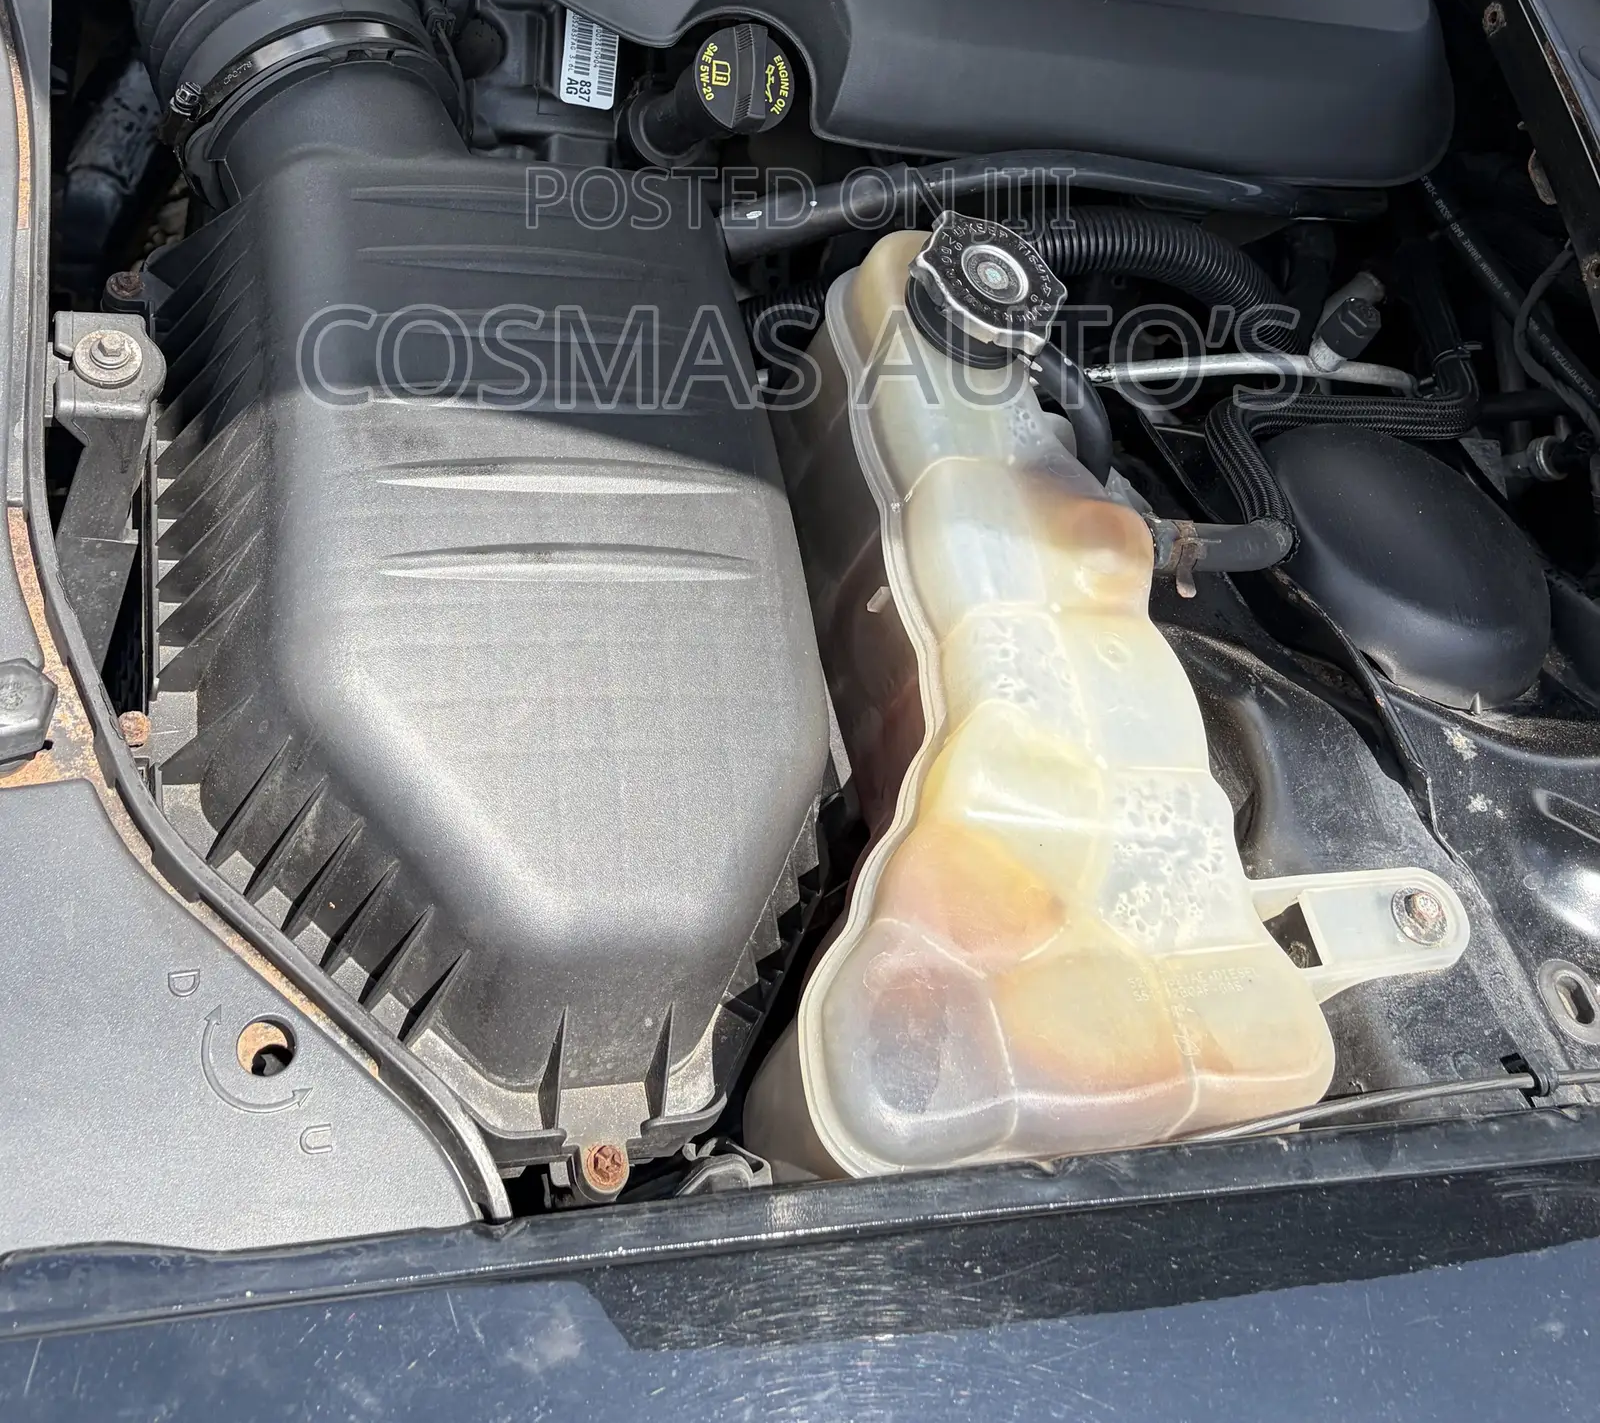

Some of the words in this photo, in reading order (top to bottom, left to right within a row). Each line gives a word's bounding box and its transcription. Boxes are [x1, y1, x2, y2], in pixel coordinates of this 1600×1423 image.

[701, 42, 718, 64] SAE
[565, 77, 579, 95] AG
[699, 64, 715, 101] 5W-20
[773, 54, 789, 98] ENGINE
[578, 80, 592, 103] 837
[769, 98, 786, 116] OIL
[167, 968, 201, 998] D
[299, 1122, 334, 1155] U
